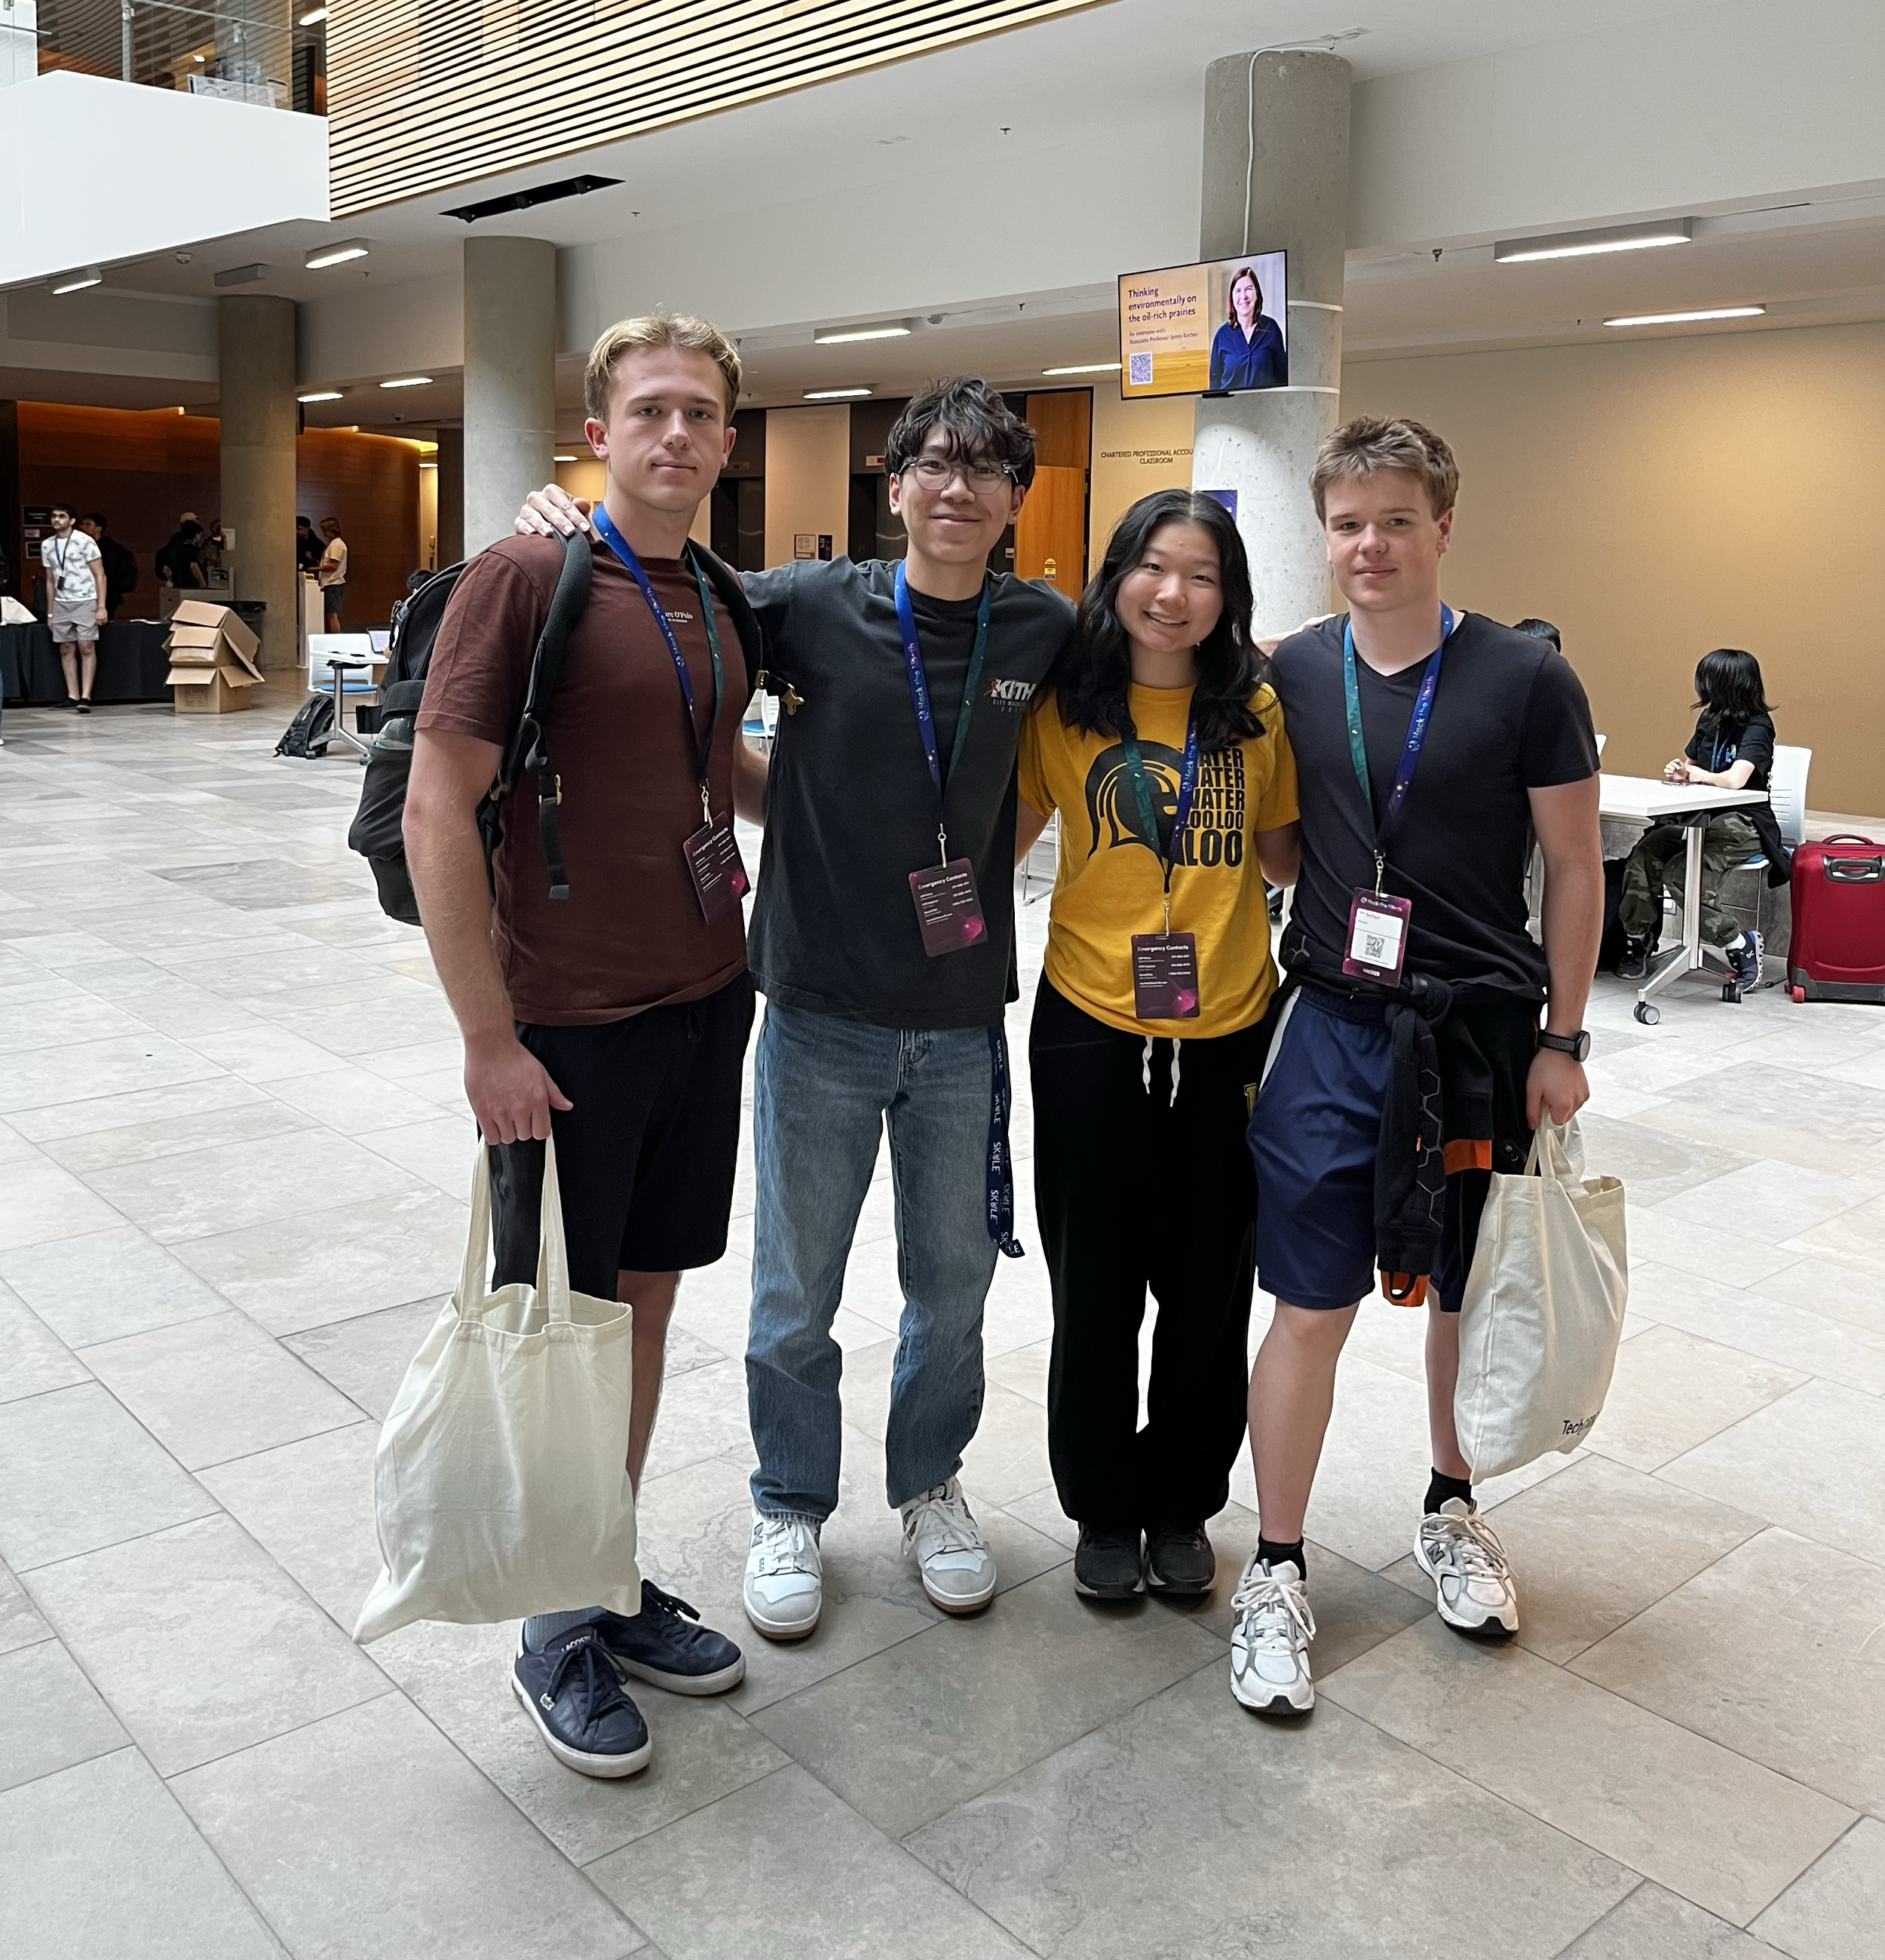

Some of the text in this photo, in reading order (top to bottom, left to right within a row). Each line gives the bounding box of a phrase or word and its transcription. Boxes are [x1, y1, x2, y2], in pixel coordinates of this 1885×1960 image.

[1128, 287, 1159, 298] Thinking
[1128, 295, 1185, 311] environmentally
[1129, 308, 1196, 323] the oil-rich prairies
[915, 686, 926, 709] Hack
[991, 678, 1037, 701] KITH
[1418, 702, 1430, 716] the
[1412, 718, 1425, 738] Hack
[1199, 747, 1244, 768] ATER
[1197, 767, 1245, 789] ATER
[1185, 830, 1243, 867] LOO
[918, 879, 946, 890] Emergency
